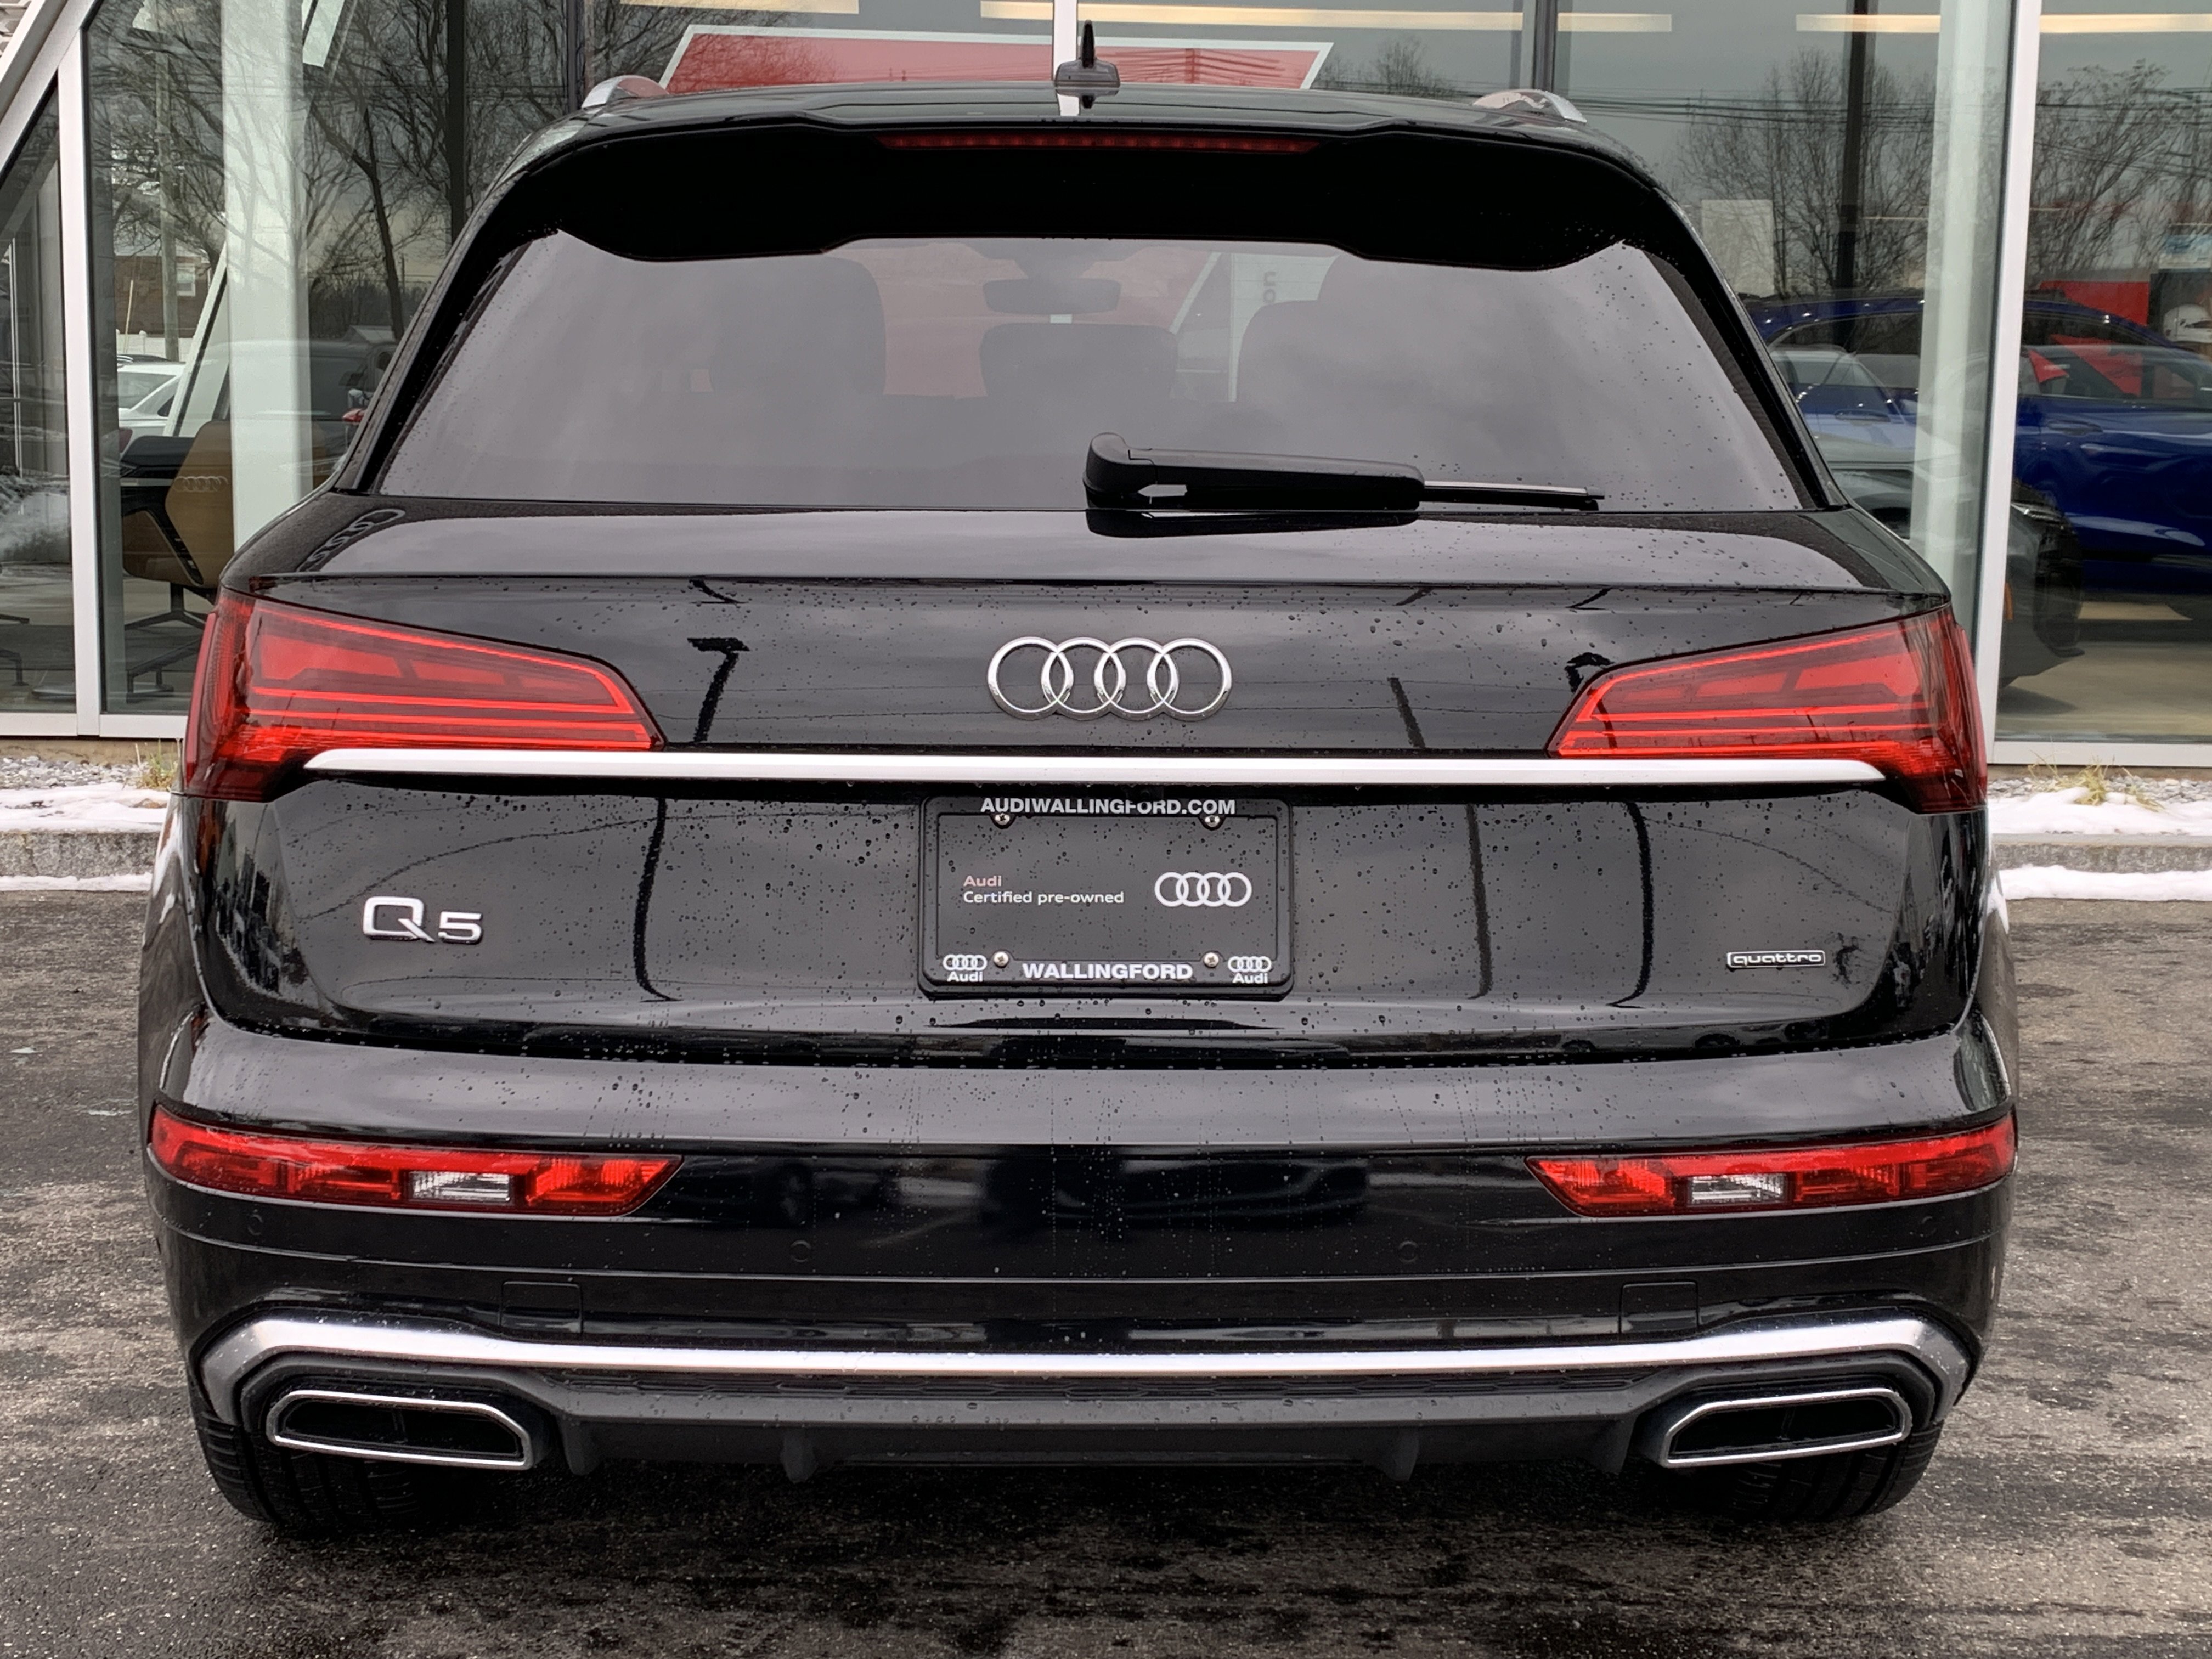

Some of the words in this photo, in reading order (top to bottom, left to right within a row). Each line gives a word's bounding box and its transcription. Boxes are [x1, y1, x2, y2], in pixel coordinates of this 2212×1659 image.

[980, 798, 1235, 814] AUDIWALLINGFORD.COM
[963, 875, 1002, 887] Audi
[963, 891, 1032, 903] Certified
[1037, 891, 1124, 905] pre-owned
[363, 896, 484, 943] Q5
[1733, 953, 1822, 966] quattro
[947, 971, 983, 982] Audi
[1022, 963, 1193, 979] WALLINGFORD
[1232, 973, 1268, 984] Audi
